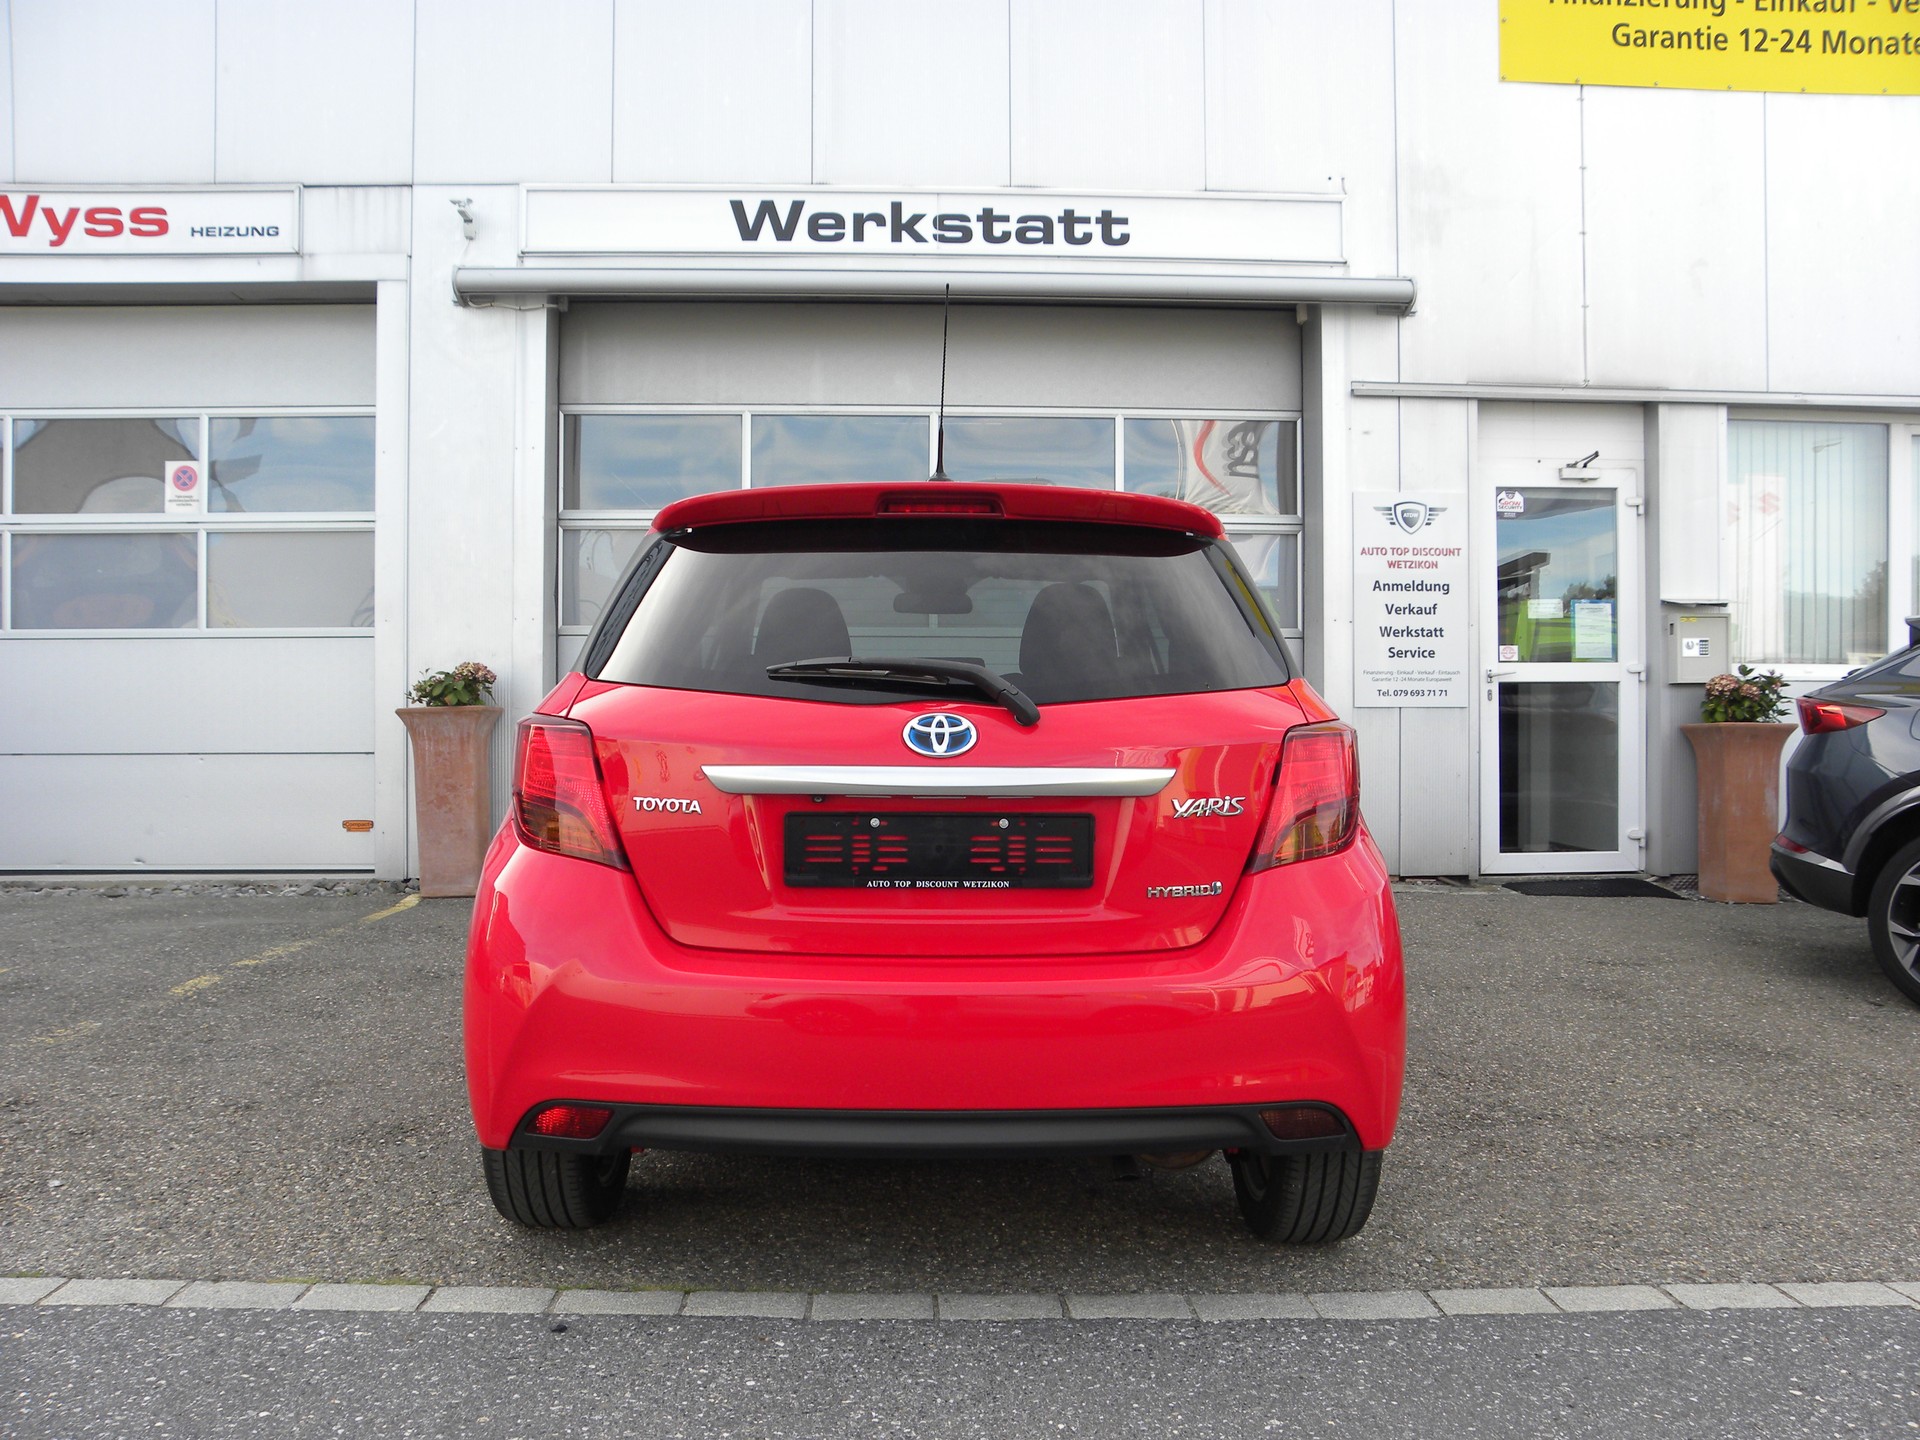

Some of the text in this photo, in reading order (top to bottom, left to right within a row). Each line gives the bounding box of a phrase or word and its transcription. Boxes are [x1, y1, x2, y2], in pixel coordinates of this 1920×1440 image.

[1612, 22, 1729, 51] Garantie
[1739, 28, 1812, 54] 12-24
[729, 199, 1131, 246] Werkstatt
[191, 226, 279, 238] HEIZUNG
[1360, 547, 1462, 557] AUTO TOP DISCOUNT
[1387, 560, 1438, 569] WETZIKON
[1372, 580, 1450, 595] Anmeldung
[1385, 603, 1438, 615] Verkauf
[1379, 626, 1444, 638] Werkstatt
[1388, 646, 1436, 659] Service
[1377, 689, 1448, 697] Tel. 079 693 71 71
[633, 796, 702, 815] TOYOTA
[866, 880, 1010, 888] AUTO TOP DISCOUNT WETZIKON
[1147, 884, 1212, 898] HYBRID
